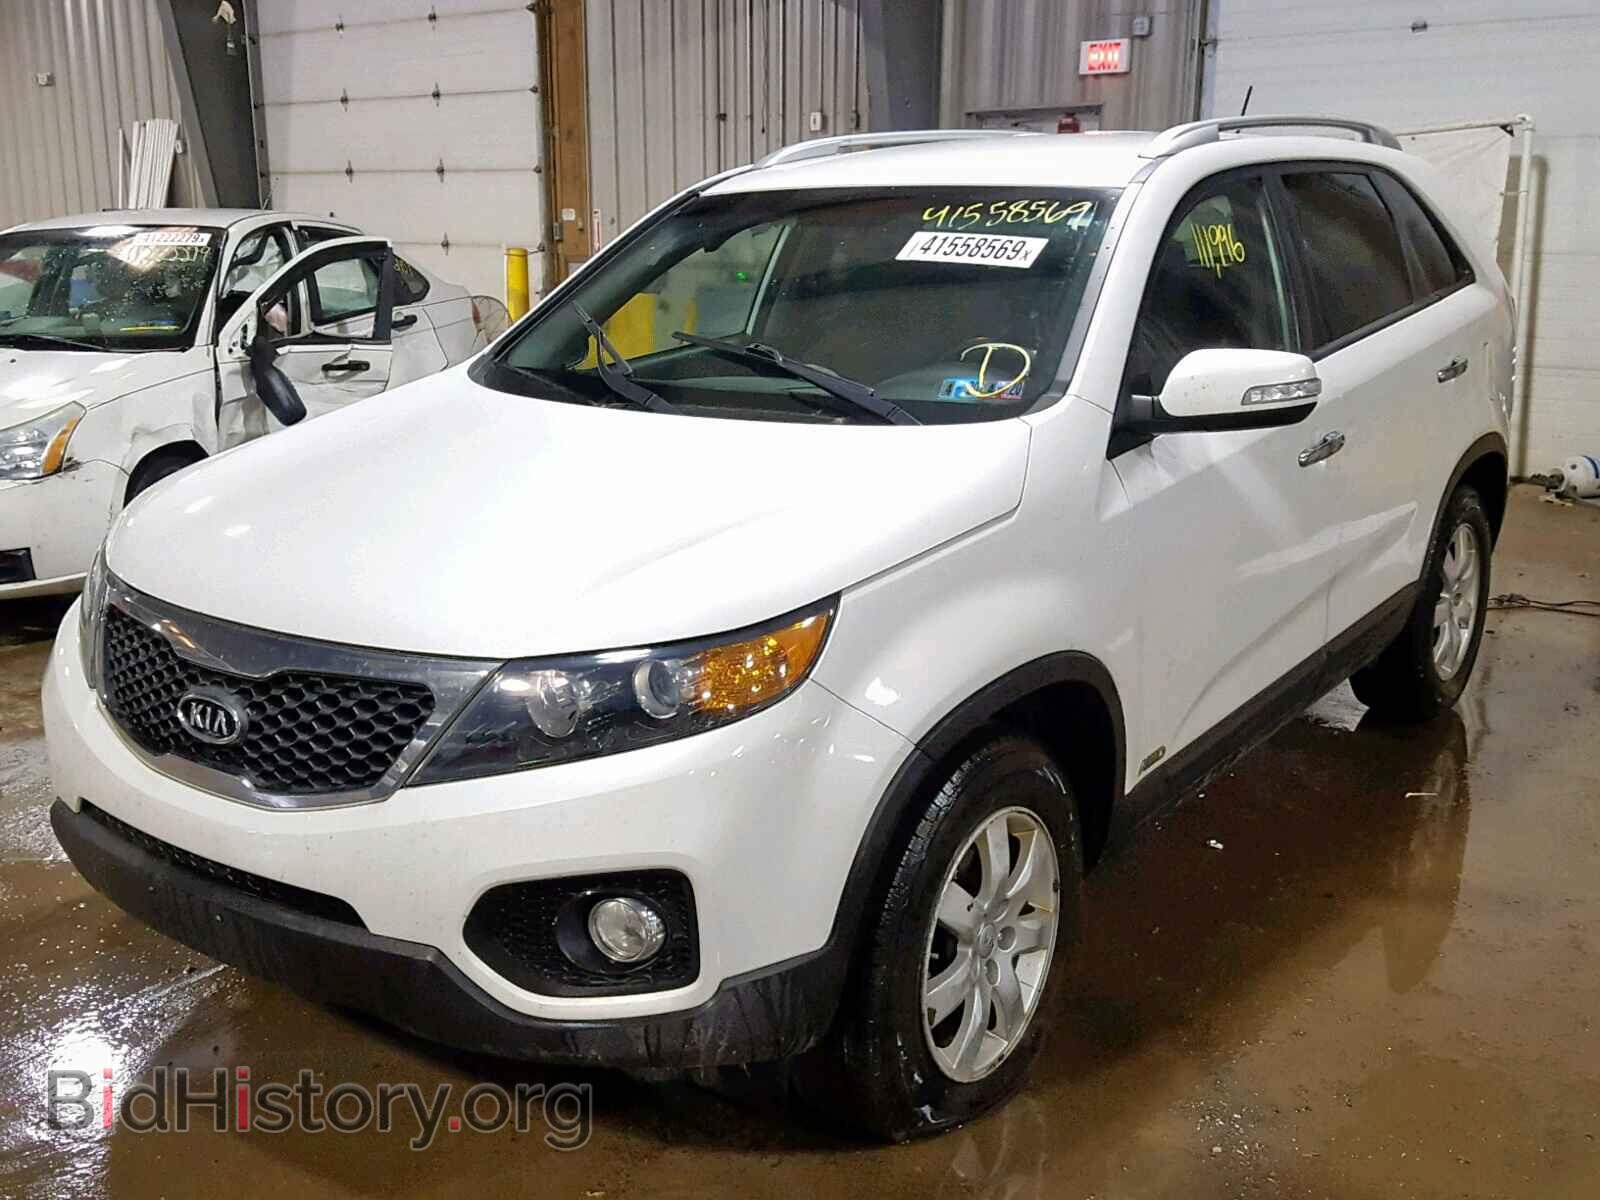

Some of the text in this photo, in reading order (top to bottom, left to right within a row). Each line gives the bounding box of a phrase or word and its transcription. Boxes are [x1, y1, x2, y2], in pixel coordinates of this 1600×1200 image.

[1087, 42, 1121, 71] EXIT
[960, 342, 1032, 398] D
[190, 701, 228, 736] KIA
